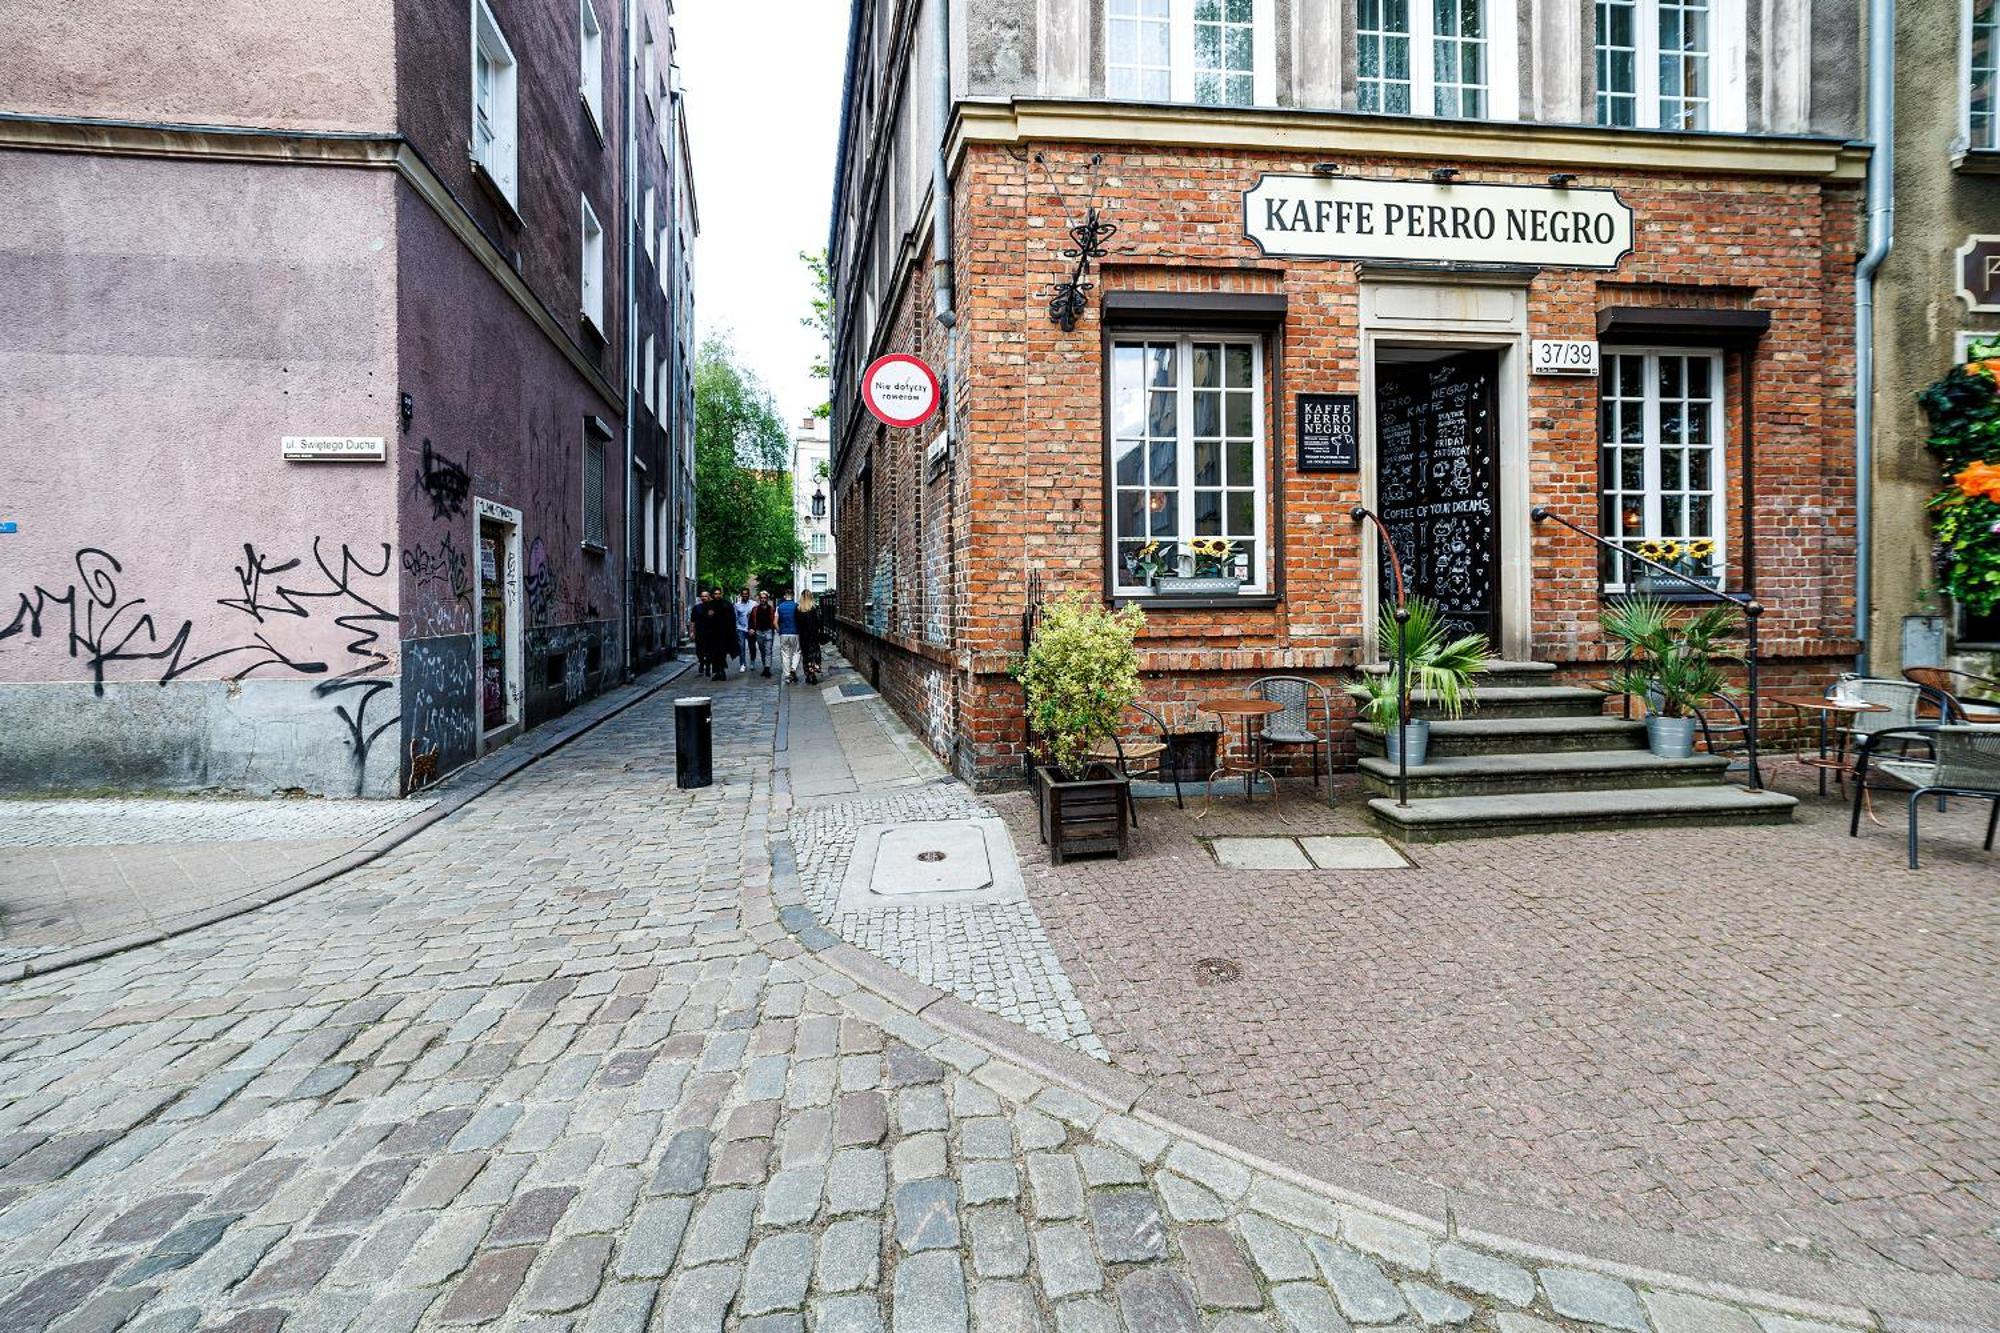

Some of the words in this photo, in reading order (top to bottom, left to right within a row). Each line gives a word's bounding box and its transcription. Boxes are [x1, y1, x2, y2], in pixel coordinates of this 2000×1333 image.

[1265, 197, 1374, 235] KAFFE
[1384, 203, 1496, 241] PERRO
[1506, 208, 1615, 244] NEGRO
[1541, 343, 1592, 364] 37/39
[875, 382, 891, 390] Nie
[894, 382, 927, 393] dotyczy
[1431, 383, 1469, 400] NEGRO
[1304, 403, 1351, 414] KAFFE
[1304, 414, 1351, 424] PERRO
[1304, 424, 1352, 434] NEGRO
[346, 439, 376, 450] Ducha
[1435, 436, 1465, 448] FRIDAY
[1433, 445, 1471, 458] SATURDAY
[1383, 508, 1414, 519] COFFEE
[1416, 506, 1429, 517] OF
[1430, 503, 1451, 515] YOUR
[1452, 498, 1490, 513] DREAMS
